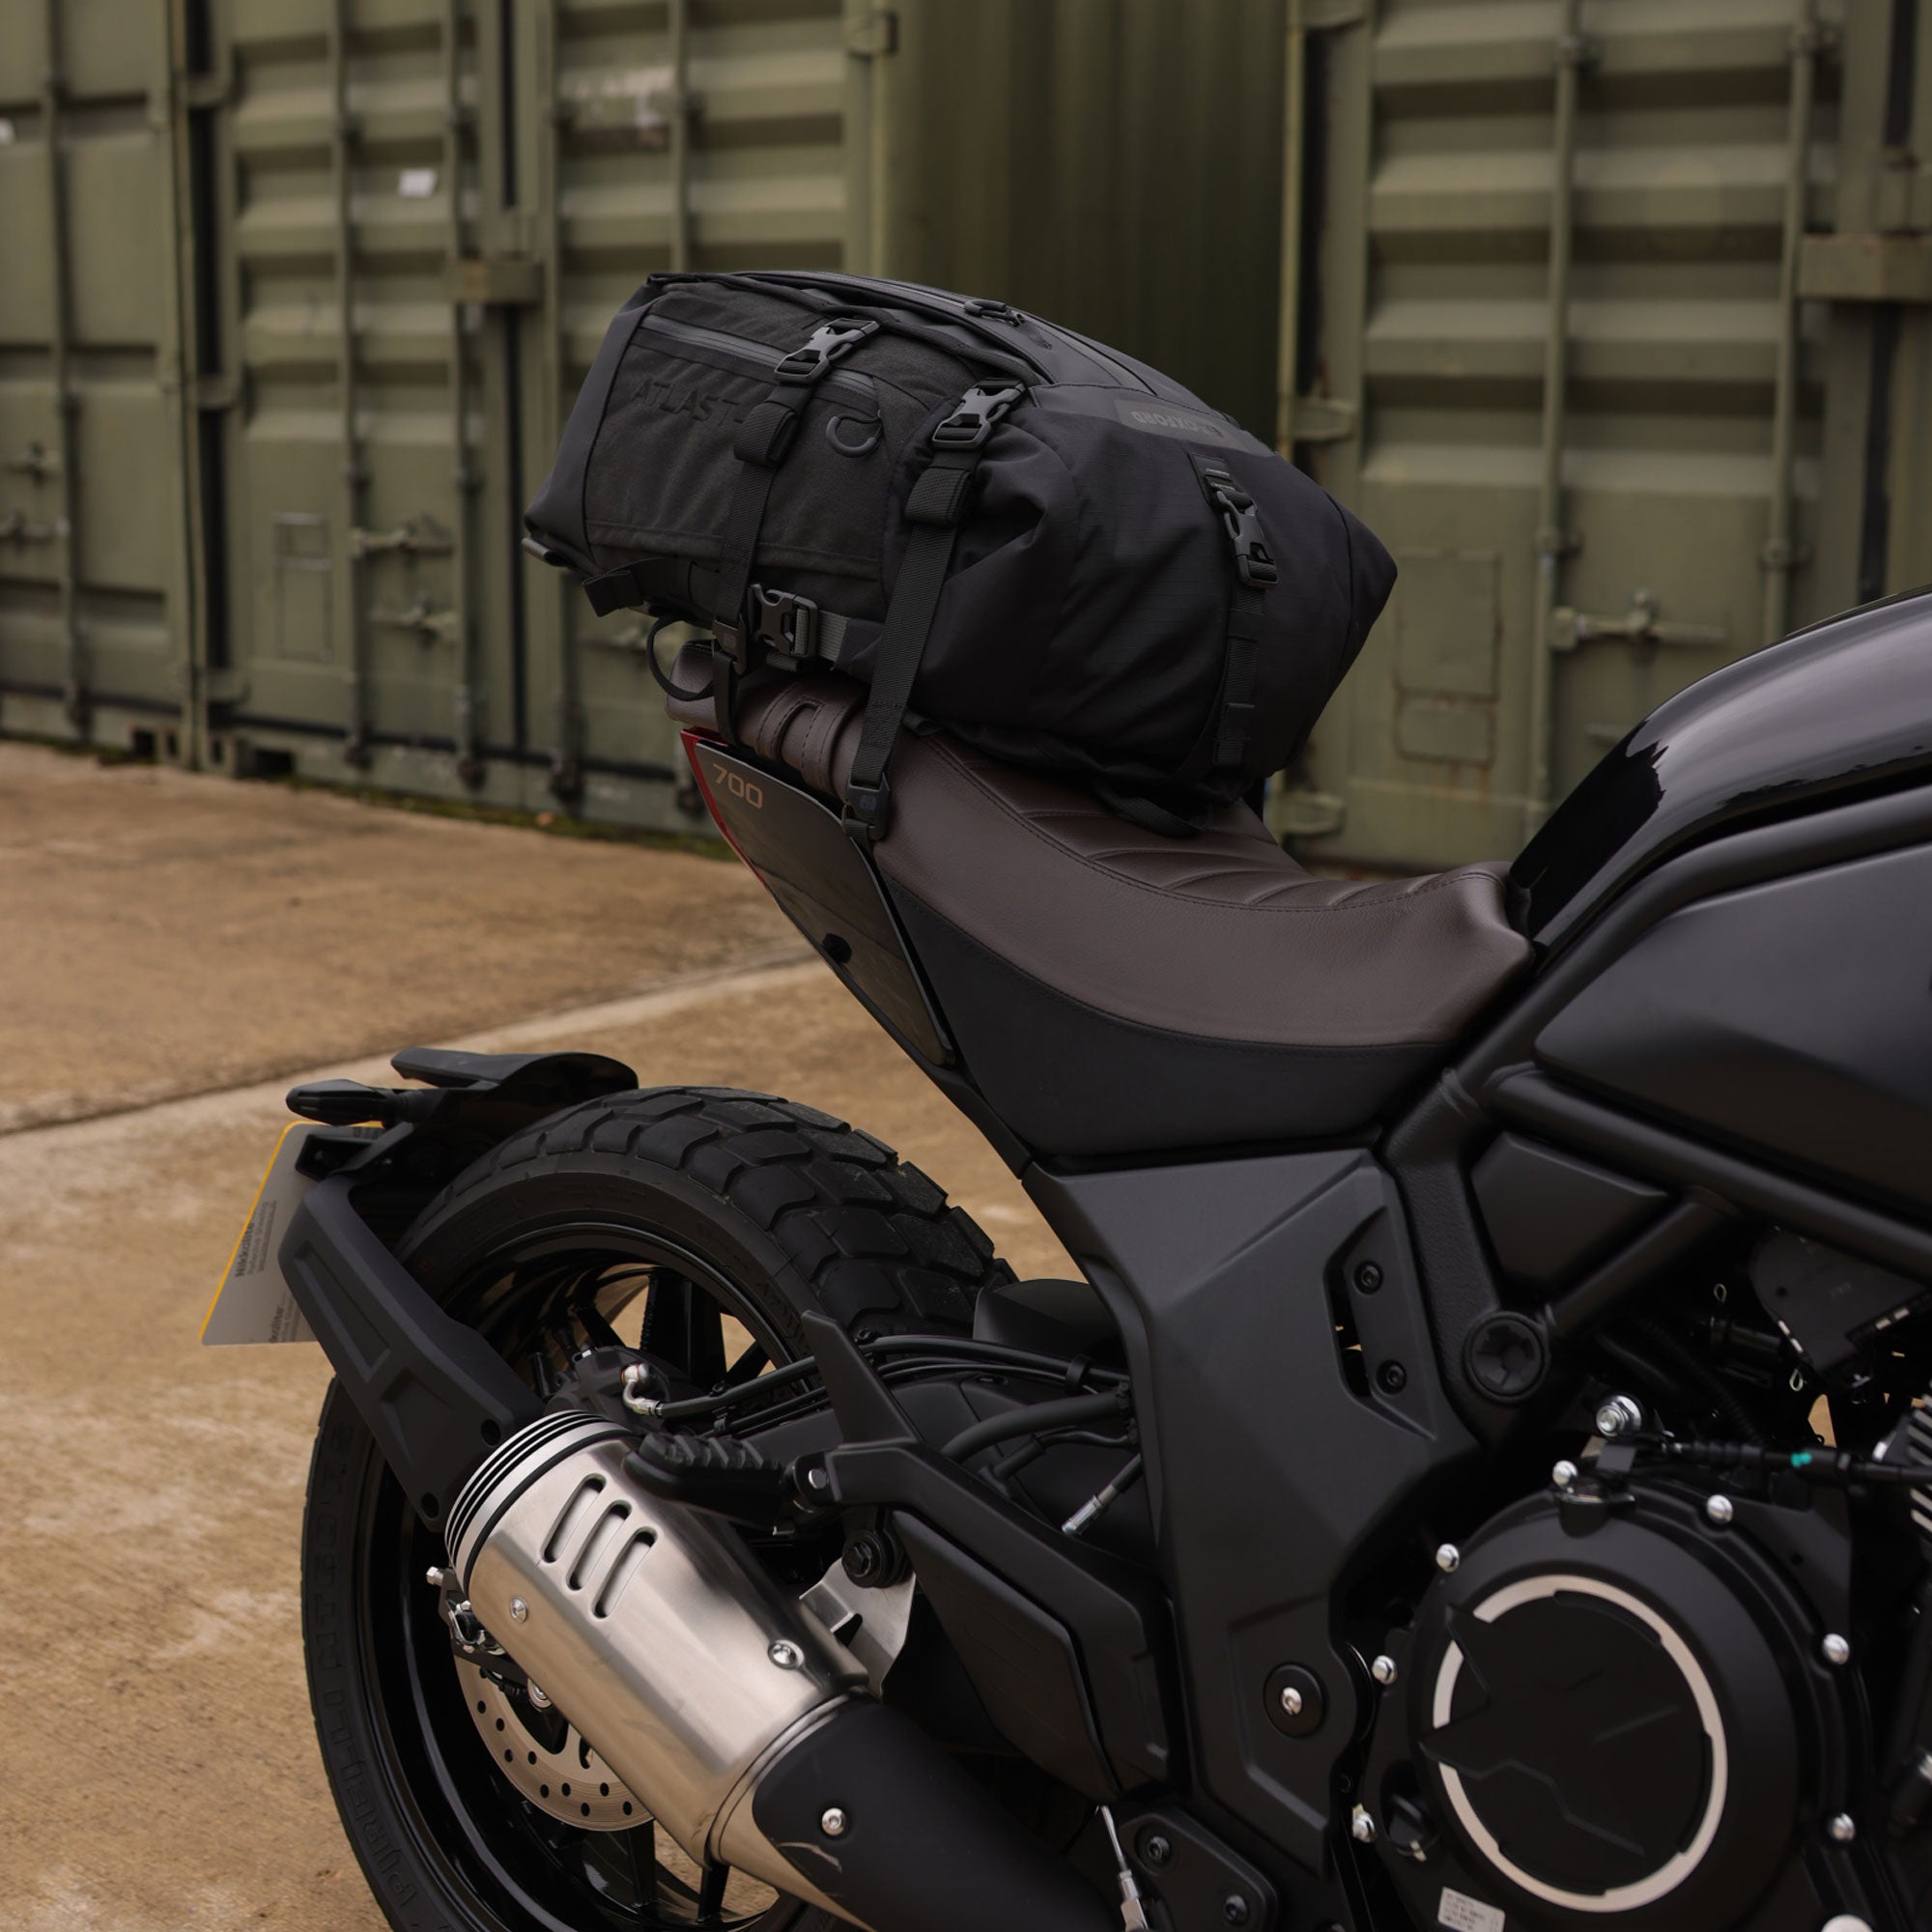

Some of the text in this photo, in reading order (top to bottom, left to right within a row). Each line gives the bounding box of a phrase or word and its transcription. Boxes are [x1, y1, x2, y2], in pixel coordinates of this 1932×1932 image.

[1130, 411, 1199, 433] OXFORD
[712, 762, 763, 810] 700
[324, 1689, 418, 1909] PIRELLI
